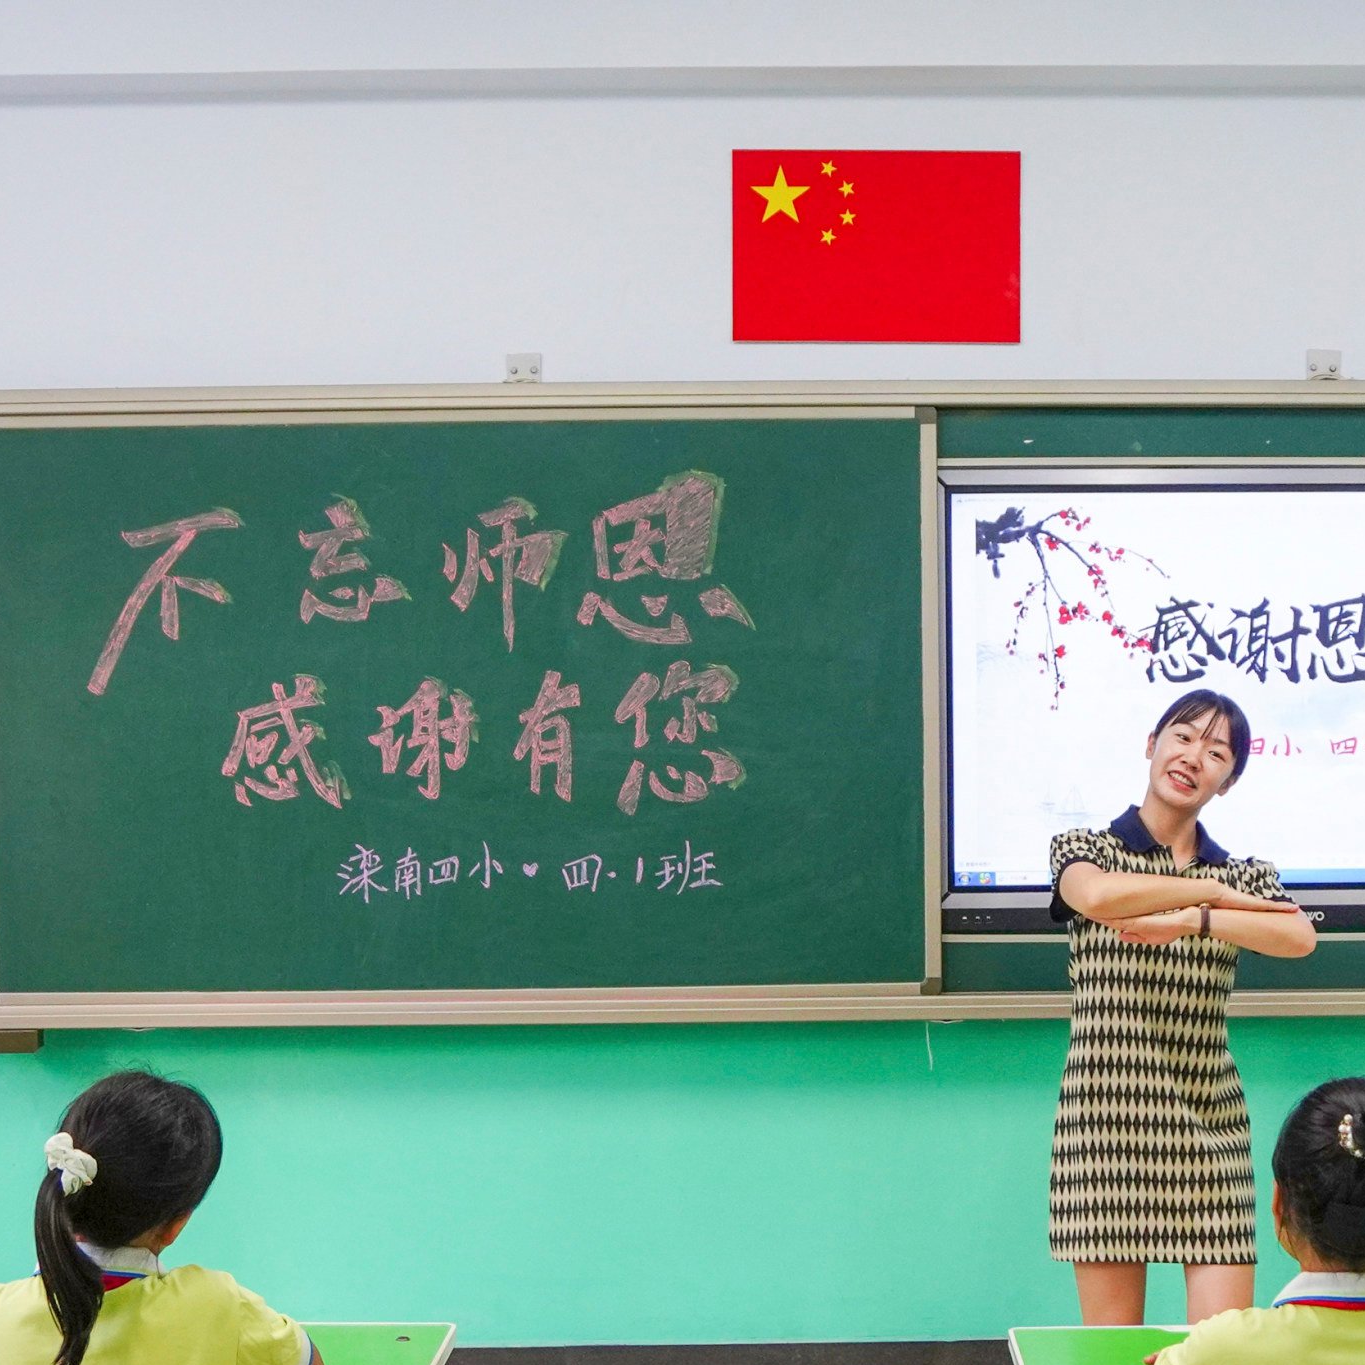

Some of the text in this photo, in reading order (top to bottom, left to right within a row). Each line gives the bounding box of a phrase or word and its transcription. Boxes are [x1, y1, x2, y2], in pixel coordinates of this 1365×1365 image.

[87, 469, 756, 695] 不忘师恩
[221, 659, 746, 815] 感谢有您
[337, 842, 503, 903] 滦南四小
